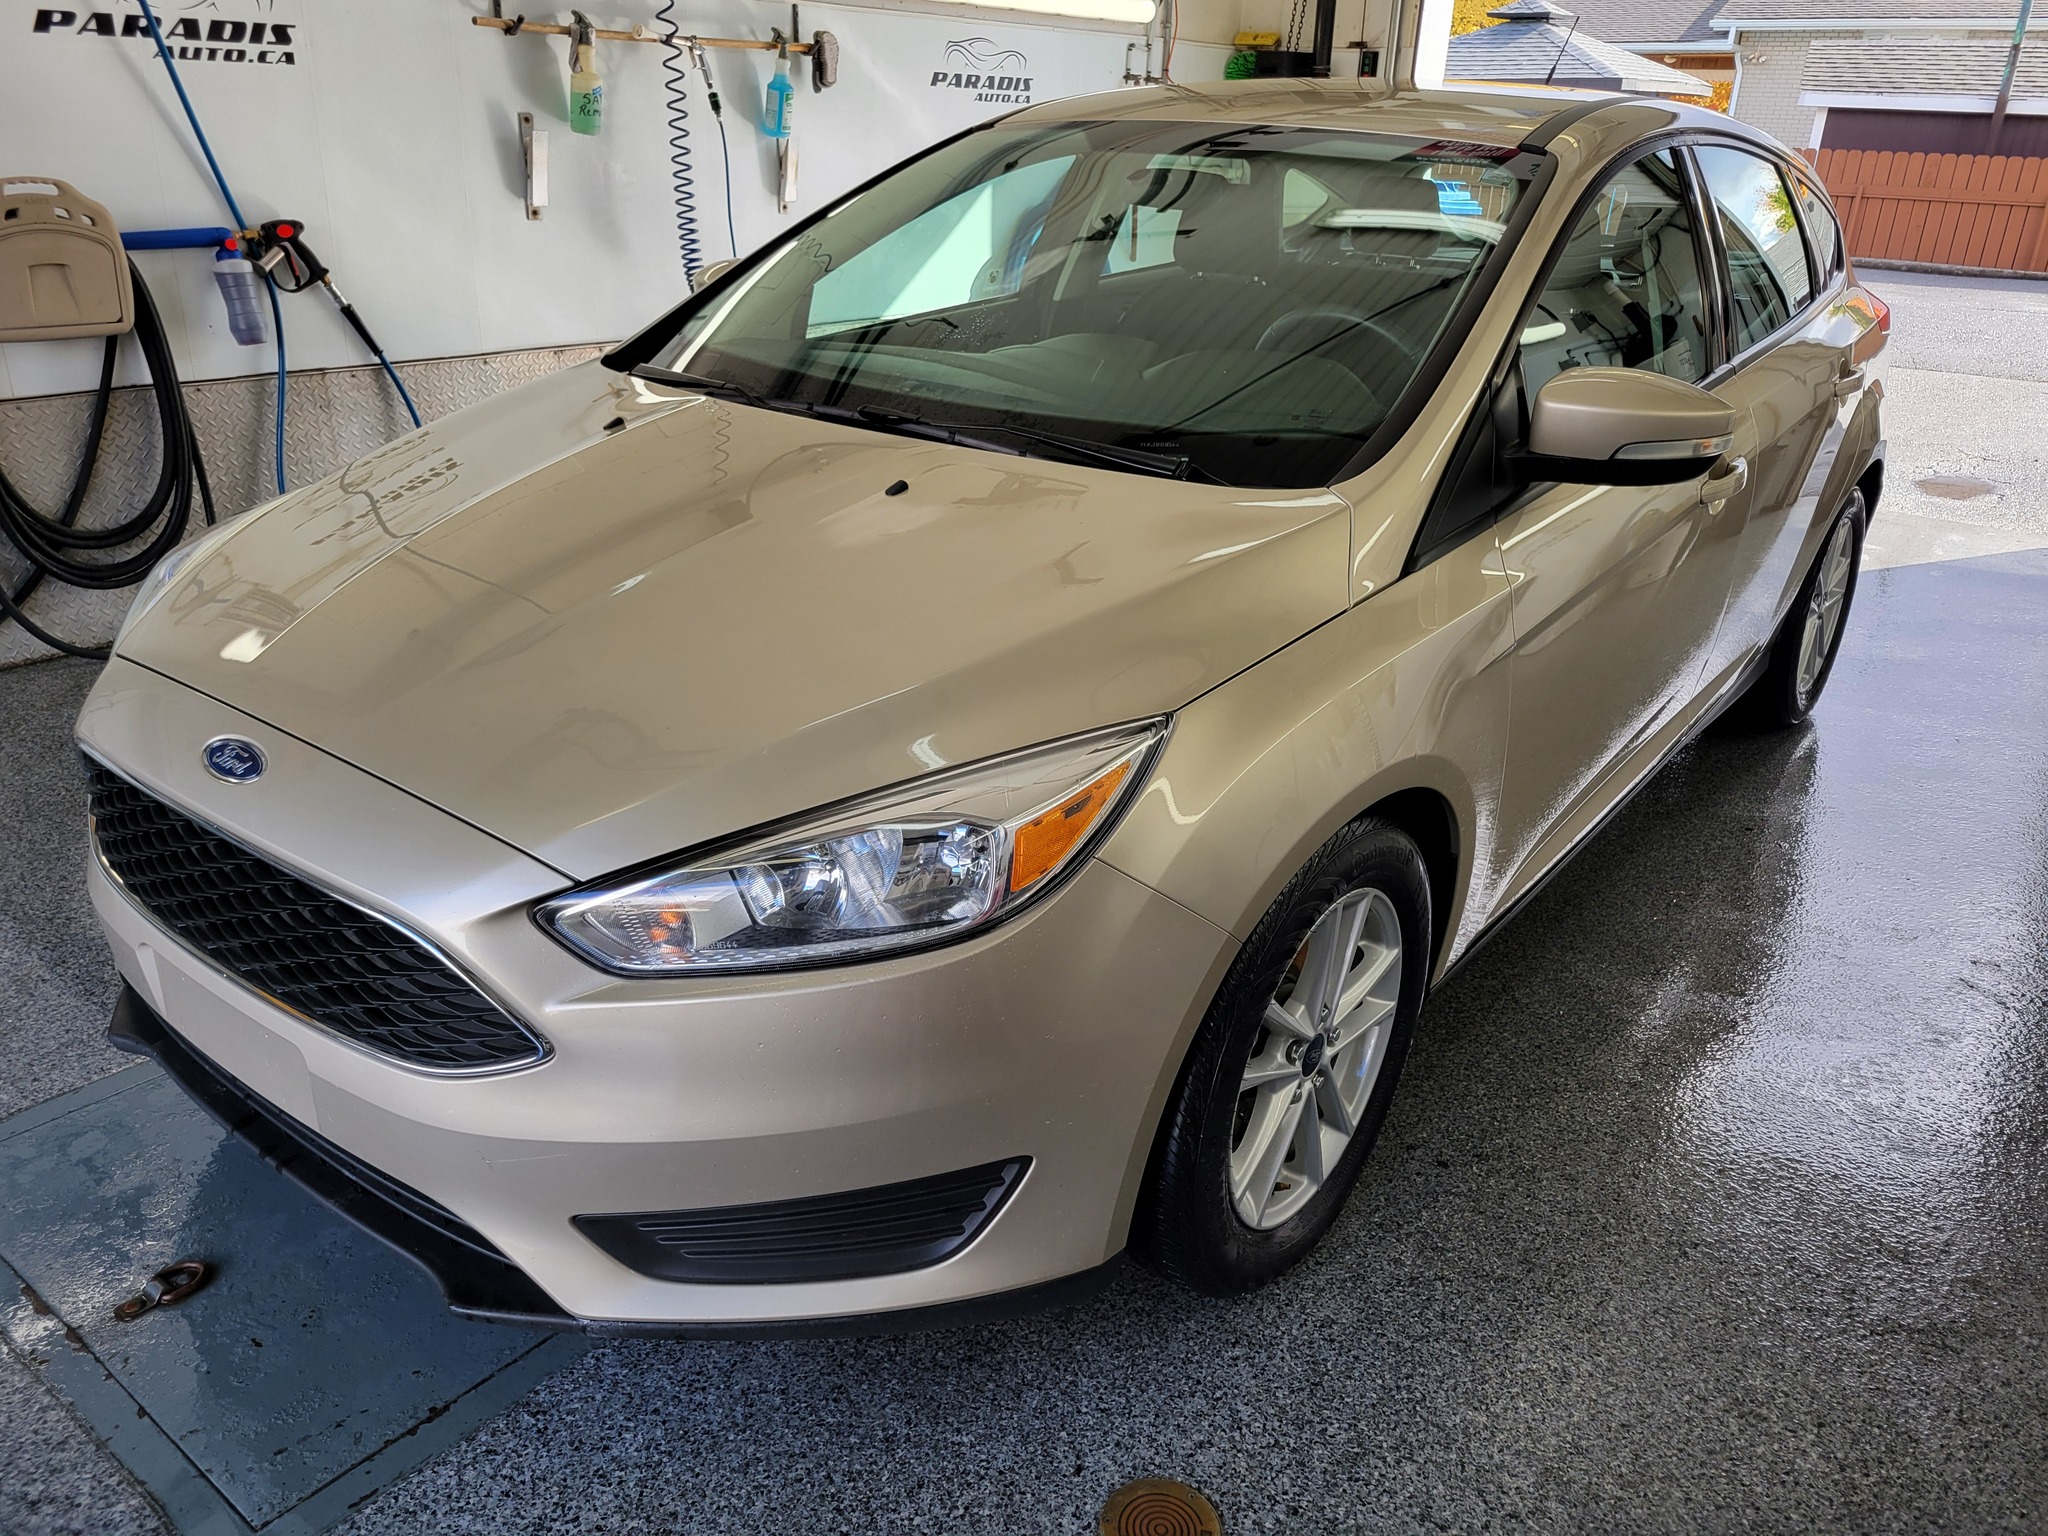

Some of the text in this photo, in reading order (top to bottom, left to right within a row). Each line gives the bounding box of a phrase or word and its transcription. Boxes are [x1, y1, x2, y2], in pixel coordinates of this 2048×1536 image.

[33, 9, 296, 46] PARADIS
[153, 46, 296, 65] AUTO.CA
[930, 72, 1034, 92] PARADIS
[974, 93, 1031, 104] AUTO.CA
[212, 745, 253, 775] Ford
